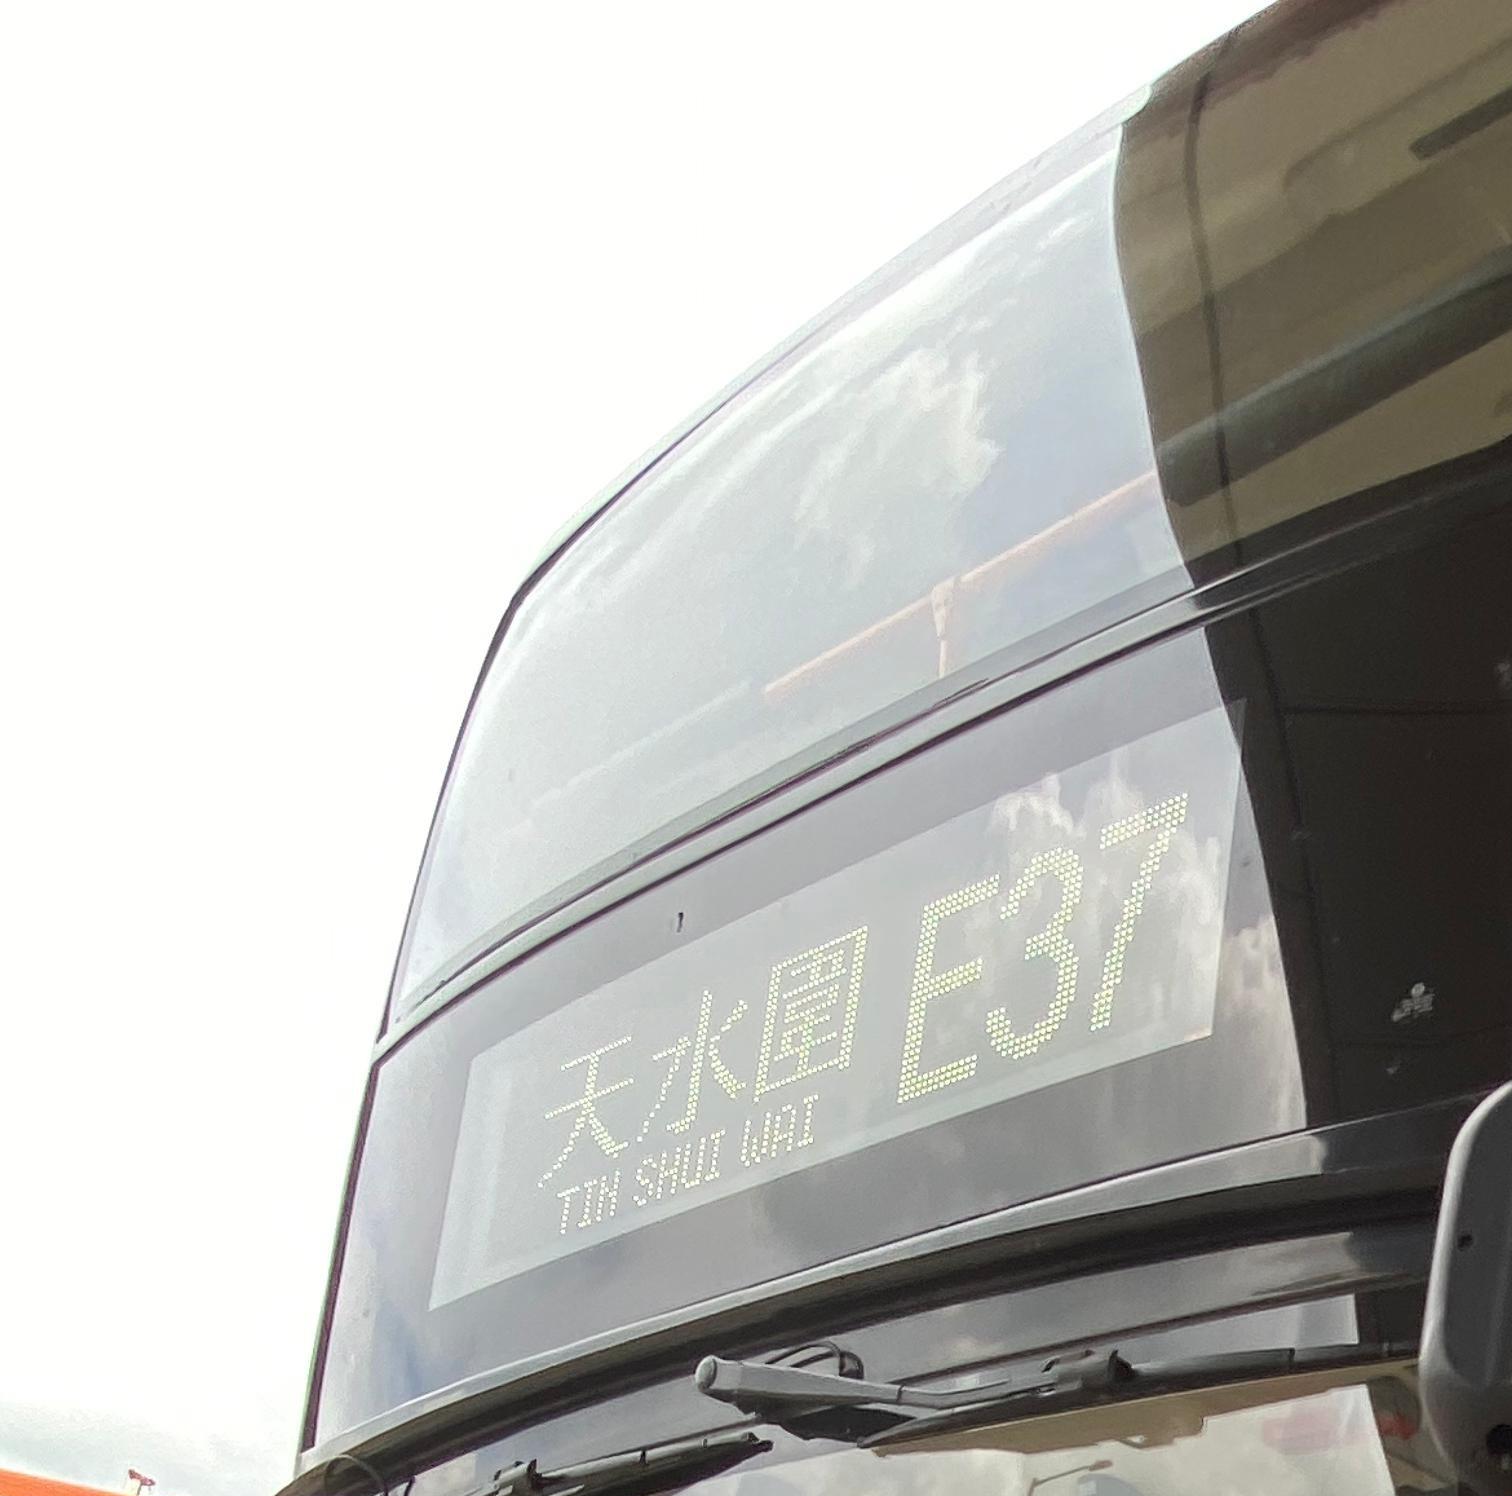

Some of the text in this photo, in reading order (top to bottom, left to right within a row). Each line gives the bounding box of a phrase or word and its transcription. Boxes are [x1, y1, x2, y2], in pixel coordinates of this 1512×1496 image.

[537, 926, 869, 1188] 天水圍
[896, 792, 1189, 1104] E37
[557, 1093, 820, 1235] TIN SHUI WAI
